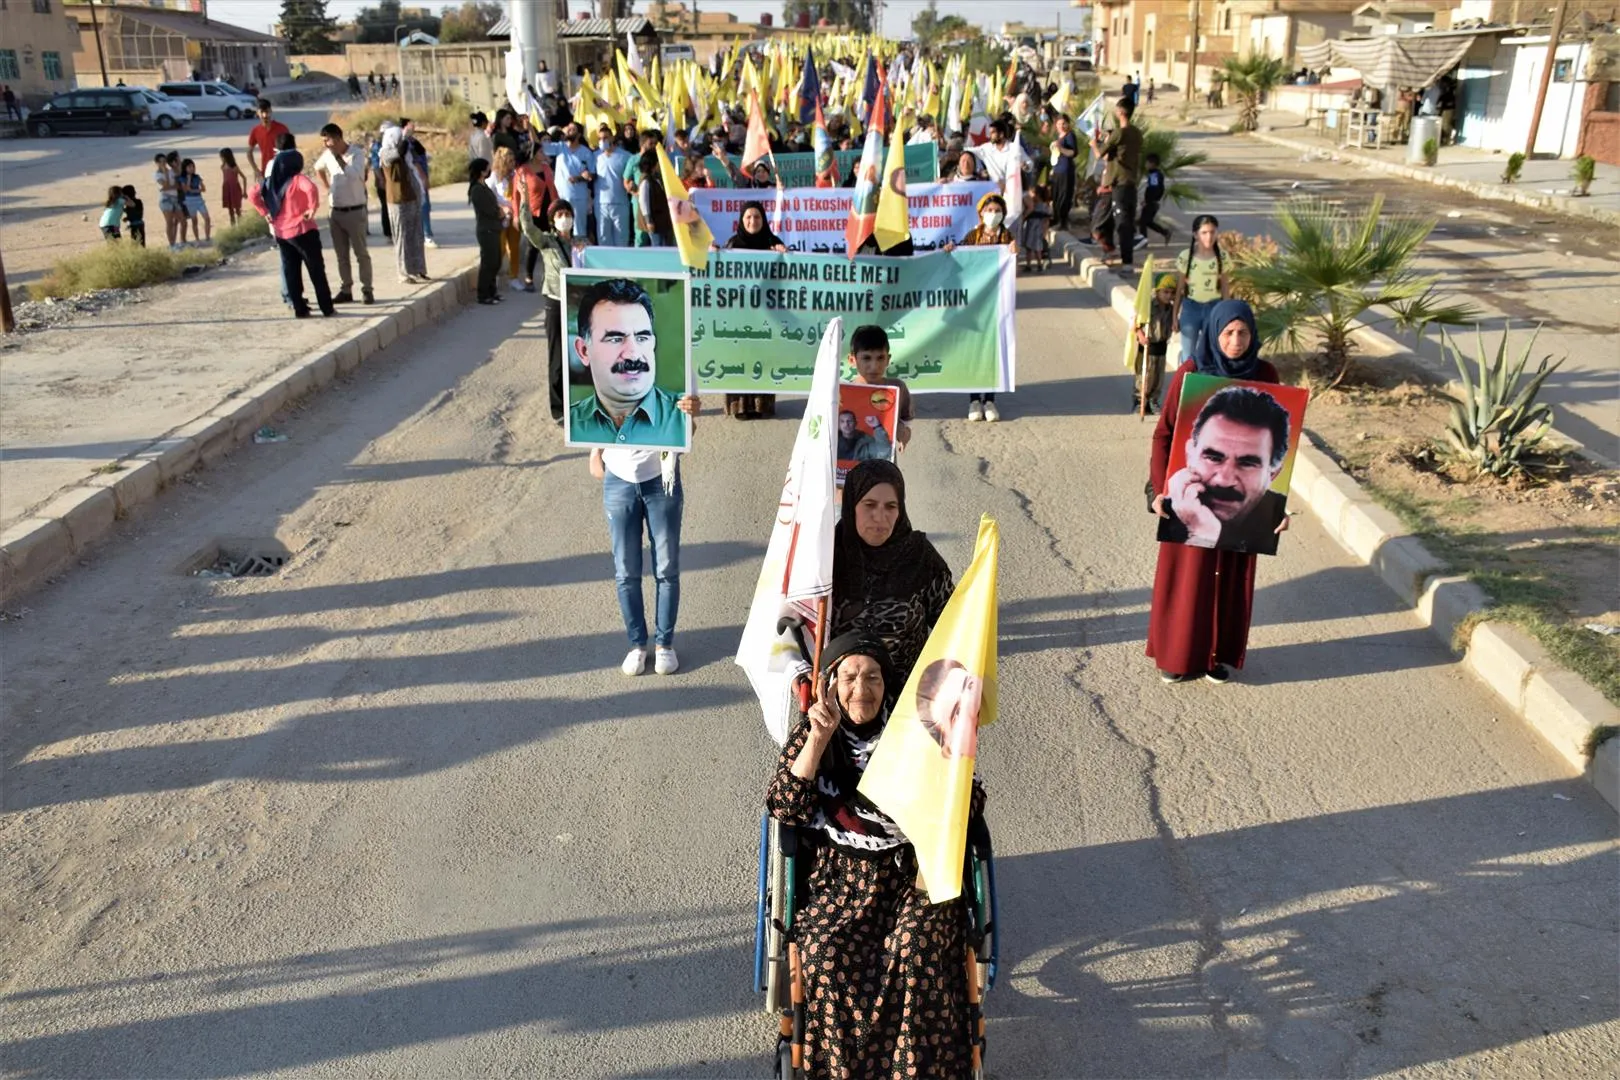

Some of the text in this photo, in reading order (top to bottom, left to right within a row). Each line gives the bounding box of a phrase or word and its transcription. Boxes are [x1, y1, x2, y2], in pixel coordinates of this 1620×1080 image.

[712, 199, 722, 213] BI
[922, 215, 952, 229] BIBIN
[714, 260, 819, 281] BERXWEDANA
[823, 261, 857, 284] GELÊ
[861, 265, 883, 285] ME
[887, 266, 900, 285] LI
[691, 283, 968, 312] RÊ SPÎ Û SERÊ KANIYÊ SILAV DIKIN
[712, 319, 773, 344] شعبنا
[698, 359, 745, 384] سري
[752, 360, 763, 380] و
